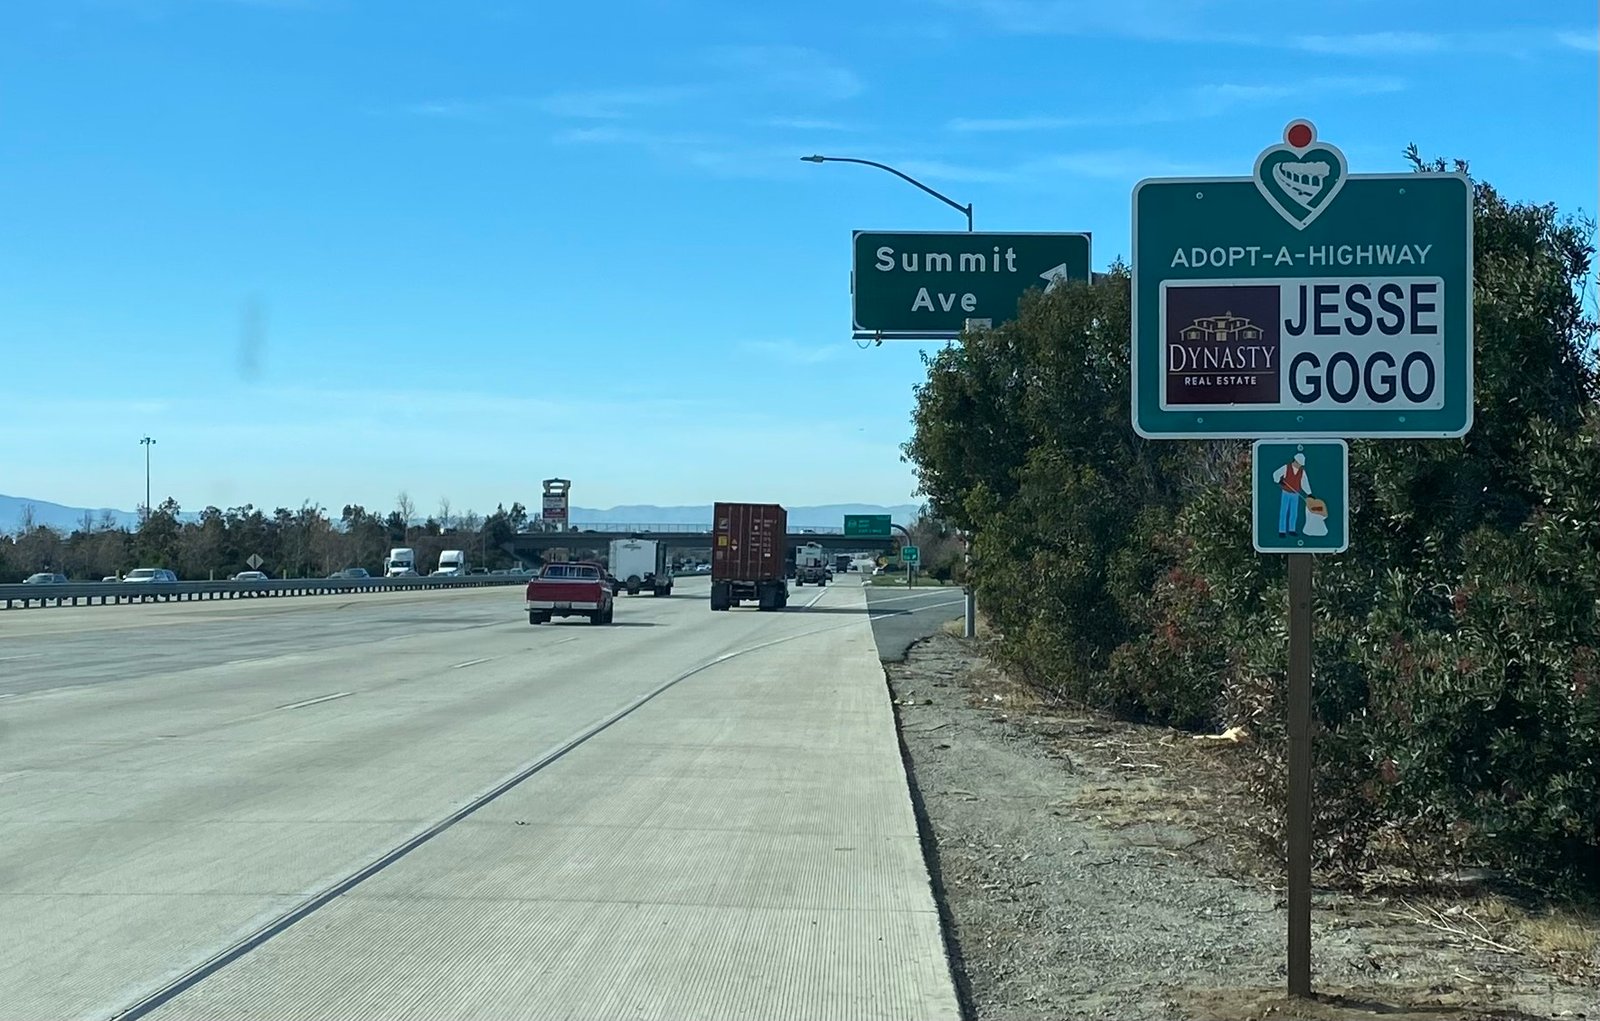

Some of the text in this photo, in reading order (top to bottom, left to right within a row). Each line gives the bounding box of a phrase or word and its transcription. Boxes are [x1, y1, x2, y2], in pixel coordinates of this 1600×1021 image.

[874, 246, 1017, 272] Summit
[1170, 244, 1433, 268] ADOPT-A-HIGHWAY
[911, 287, 978, 312] Ave
[1284, 283, 1438, 337] JESSE
[1168, 344, 1276, 372] DYNASTY
[1184, 376, 1257, 386] REAL ESTATE
[1288, 351, 1436, 404] GOGO
